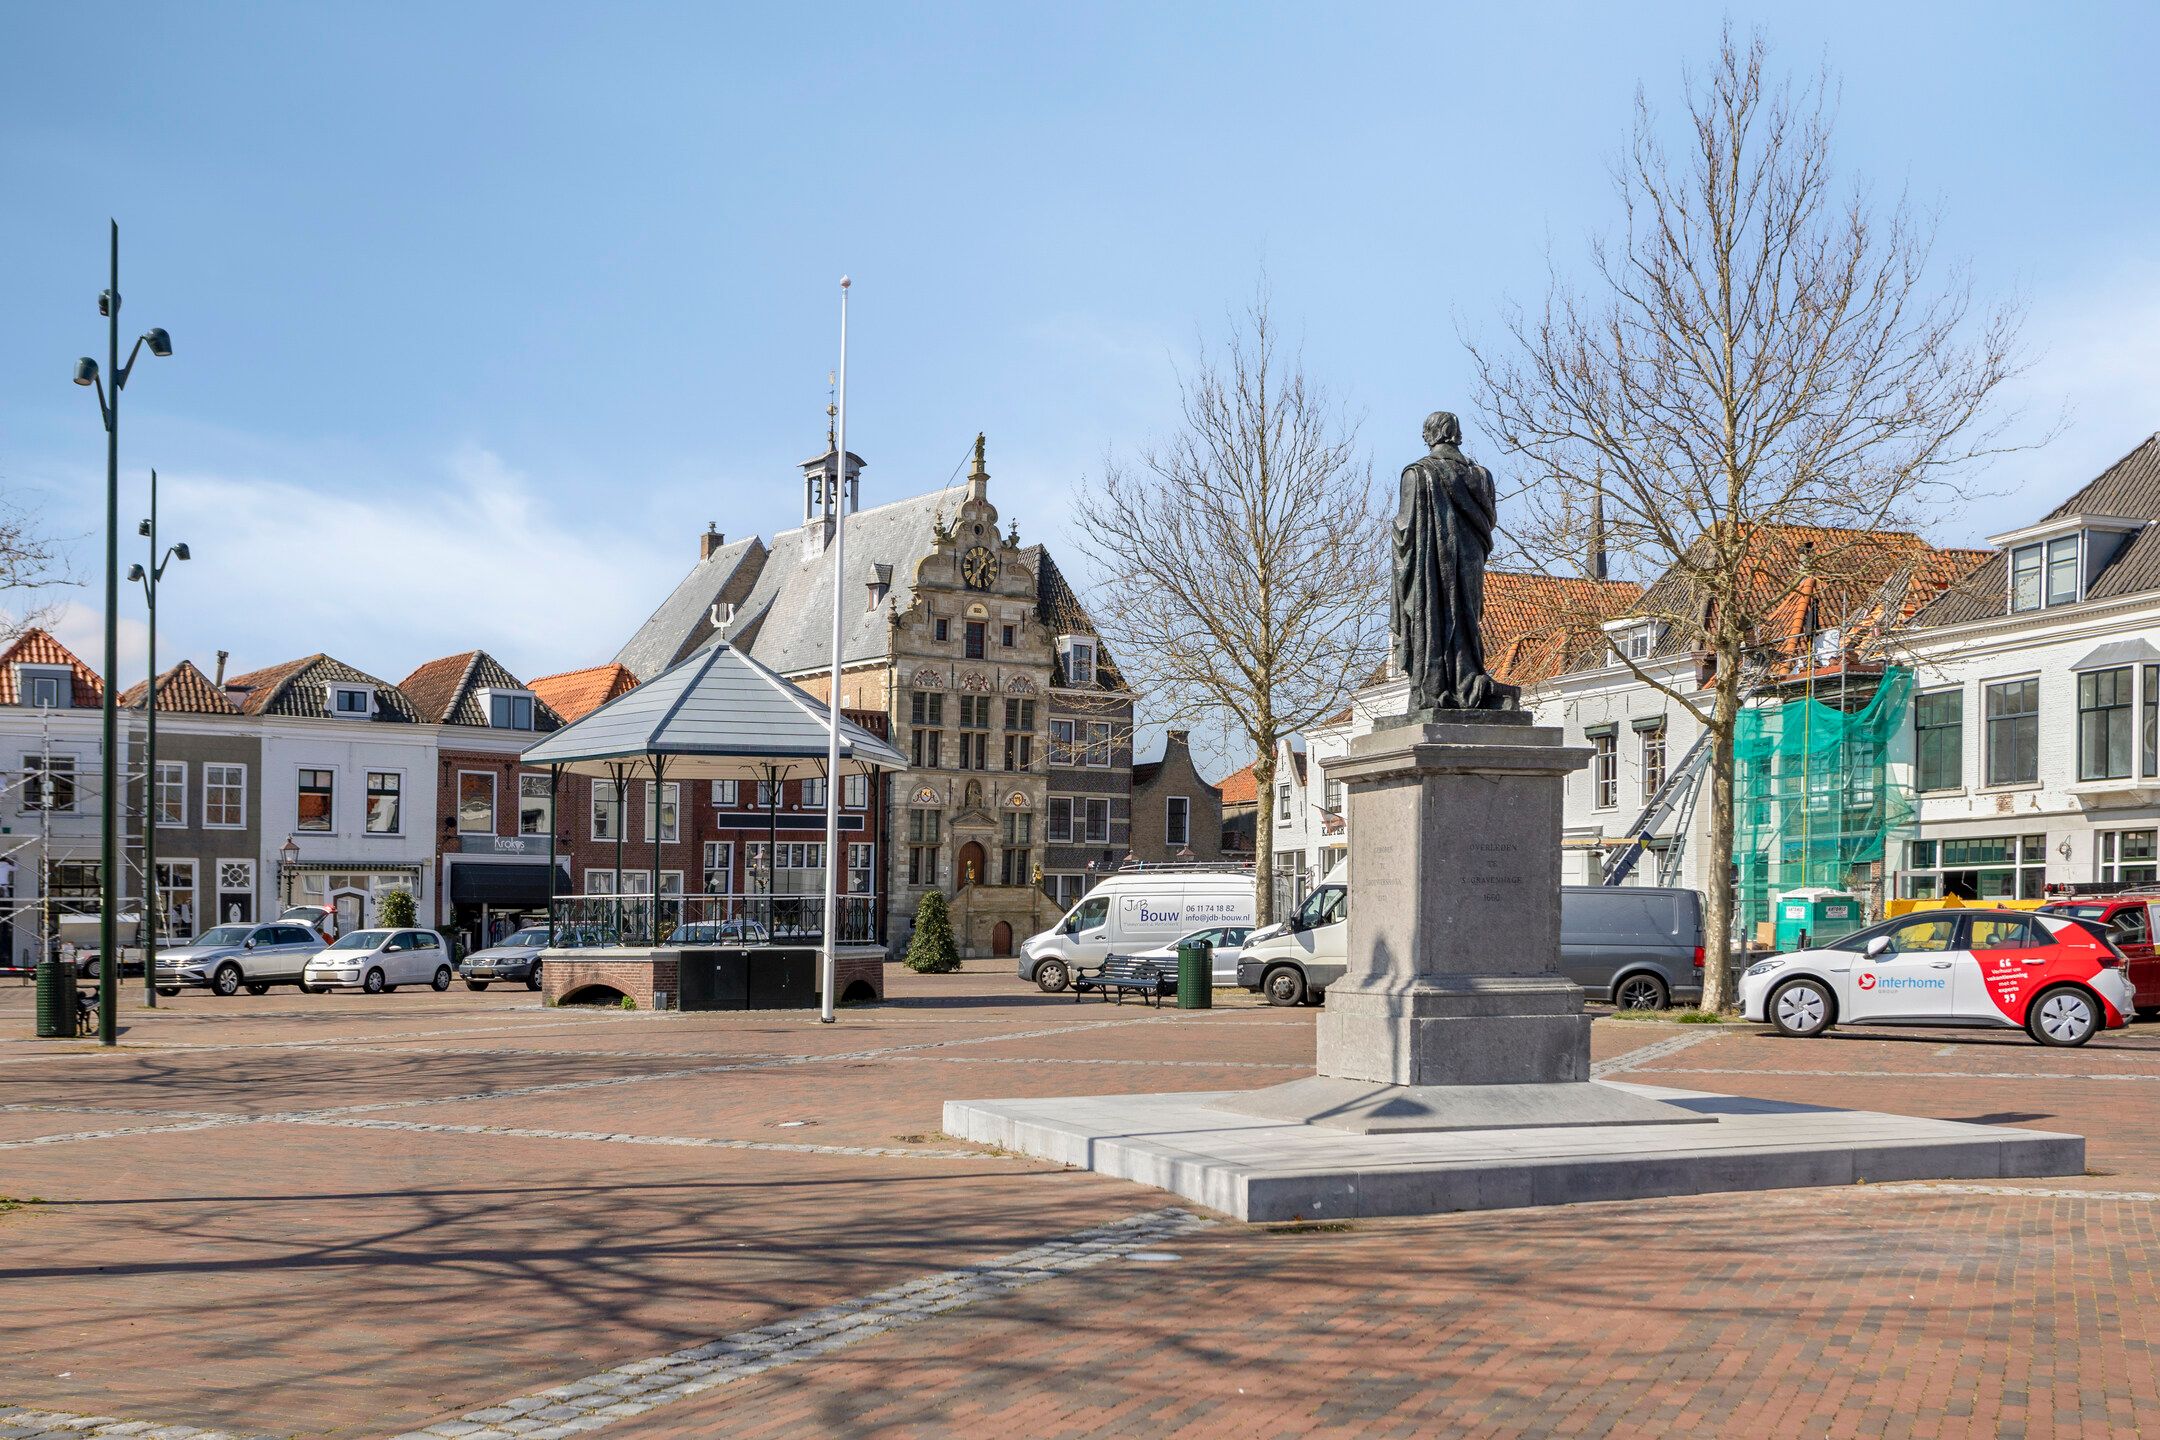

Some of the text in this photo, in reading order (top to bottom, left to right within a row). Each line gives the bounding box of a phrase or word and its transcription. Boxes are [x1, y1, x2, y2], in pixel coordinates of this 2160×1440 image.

[1469, 843, 1517, 852] OVERLEDEN
[1185, 904, 1235, 913] 06 11 74 18 82
[1140, 909, 1180, 922] Bouw
[1185, 913, 1251, 924] info@jdb-bouw.nl
[1878, 976, 1945, 989] interhome
